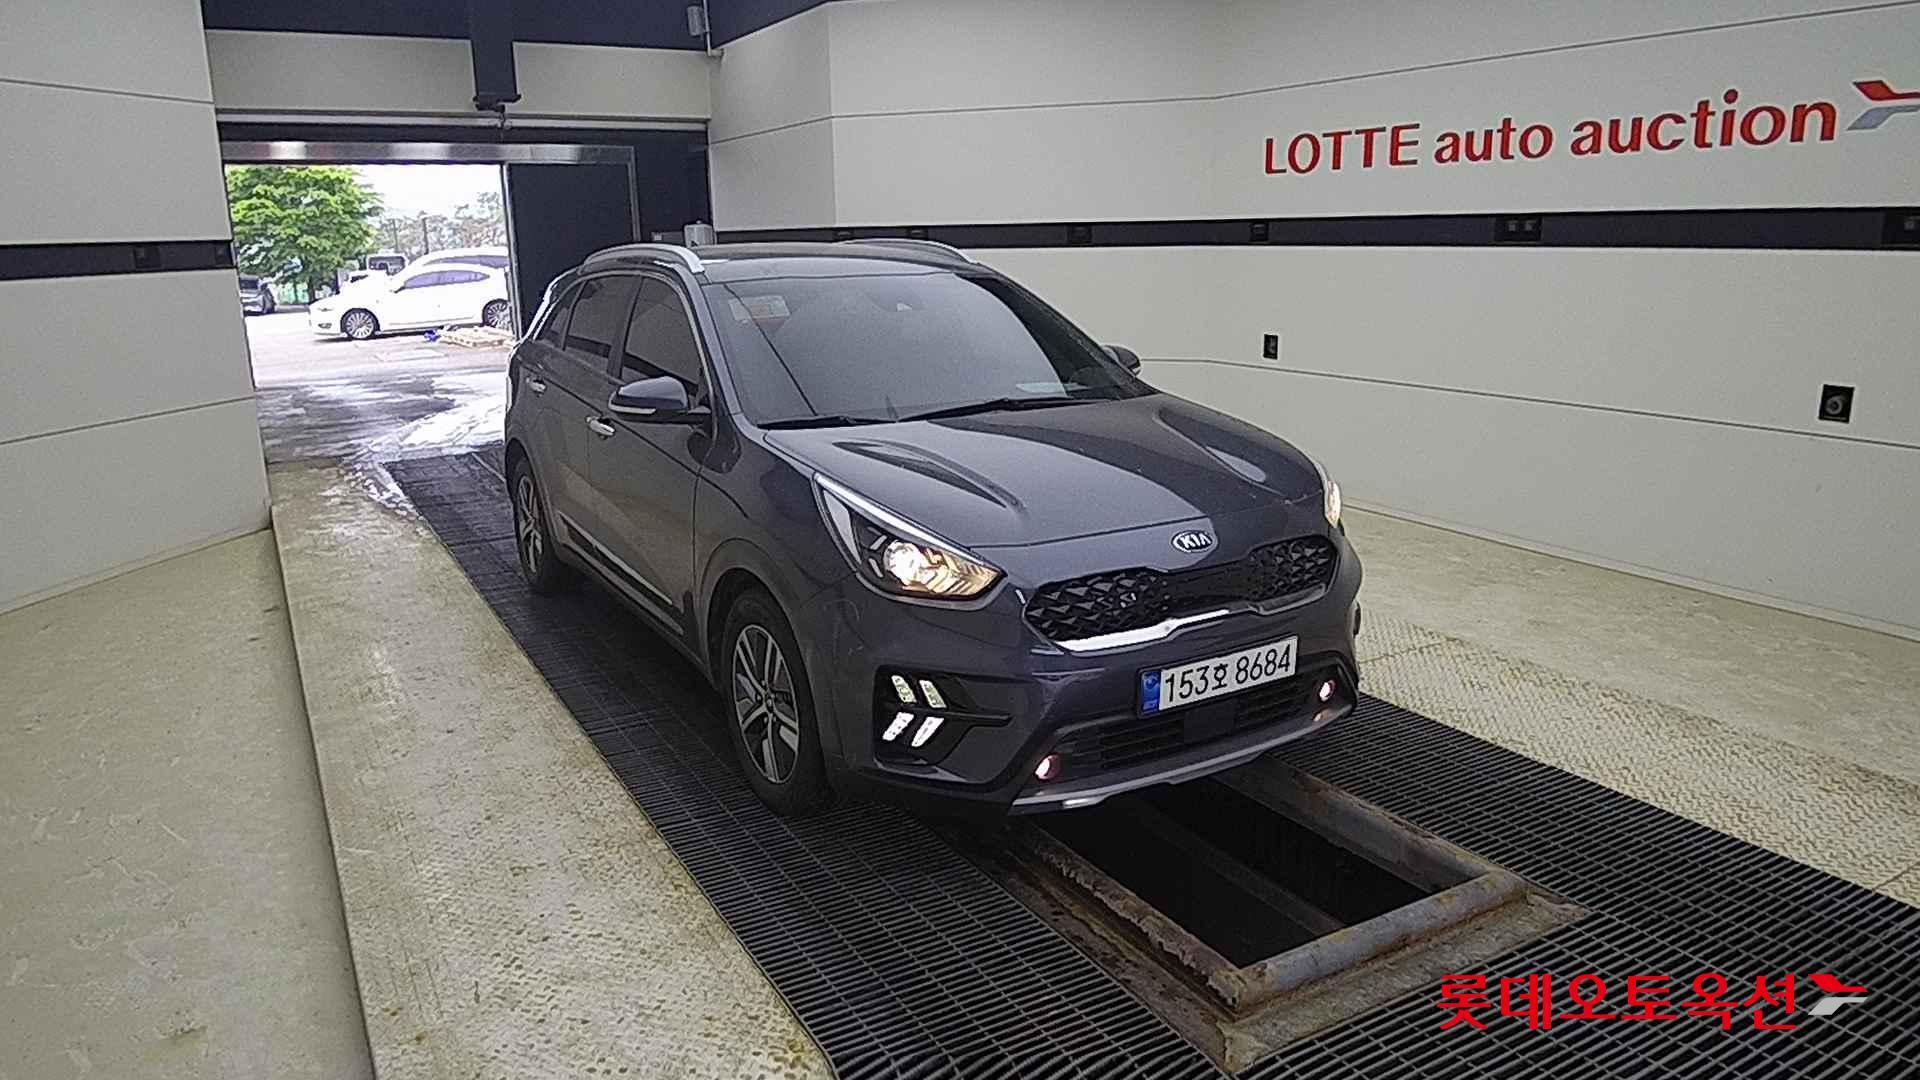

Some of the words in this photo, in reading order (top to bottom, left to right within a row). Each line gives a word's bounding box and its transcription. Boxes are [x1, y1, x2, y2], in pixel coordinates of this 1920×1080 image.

[1265, 123, 1420, 174] LOTTE
[1434, 117, 1554, 164] auto
[1569, 88, 1838, 157] auction
[1180, 532, 1212, 549] KIA
[1165, 662, 1228, 702] 153호
[1235, 644, 1291, 685] 8684
